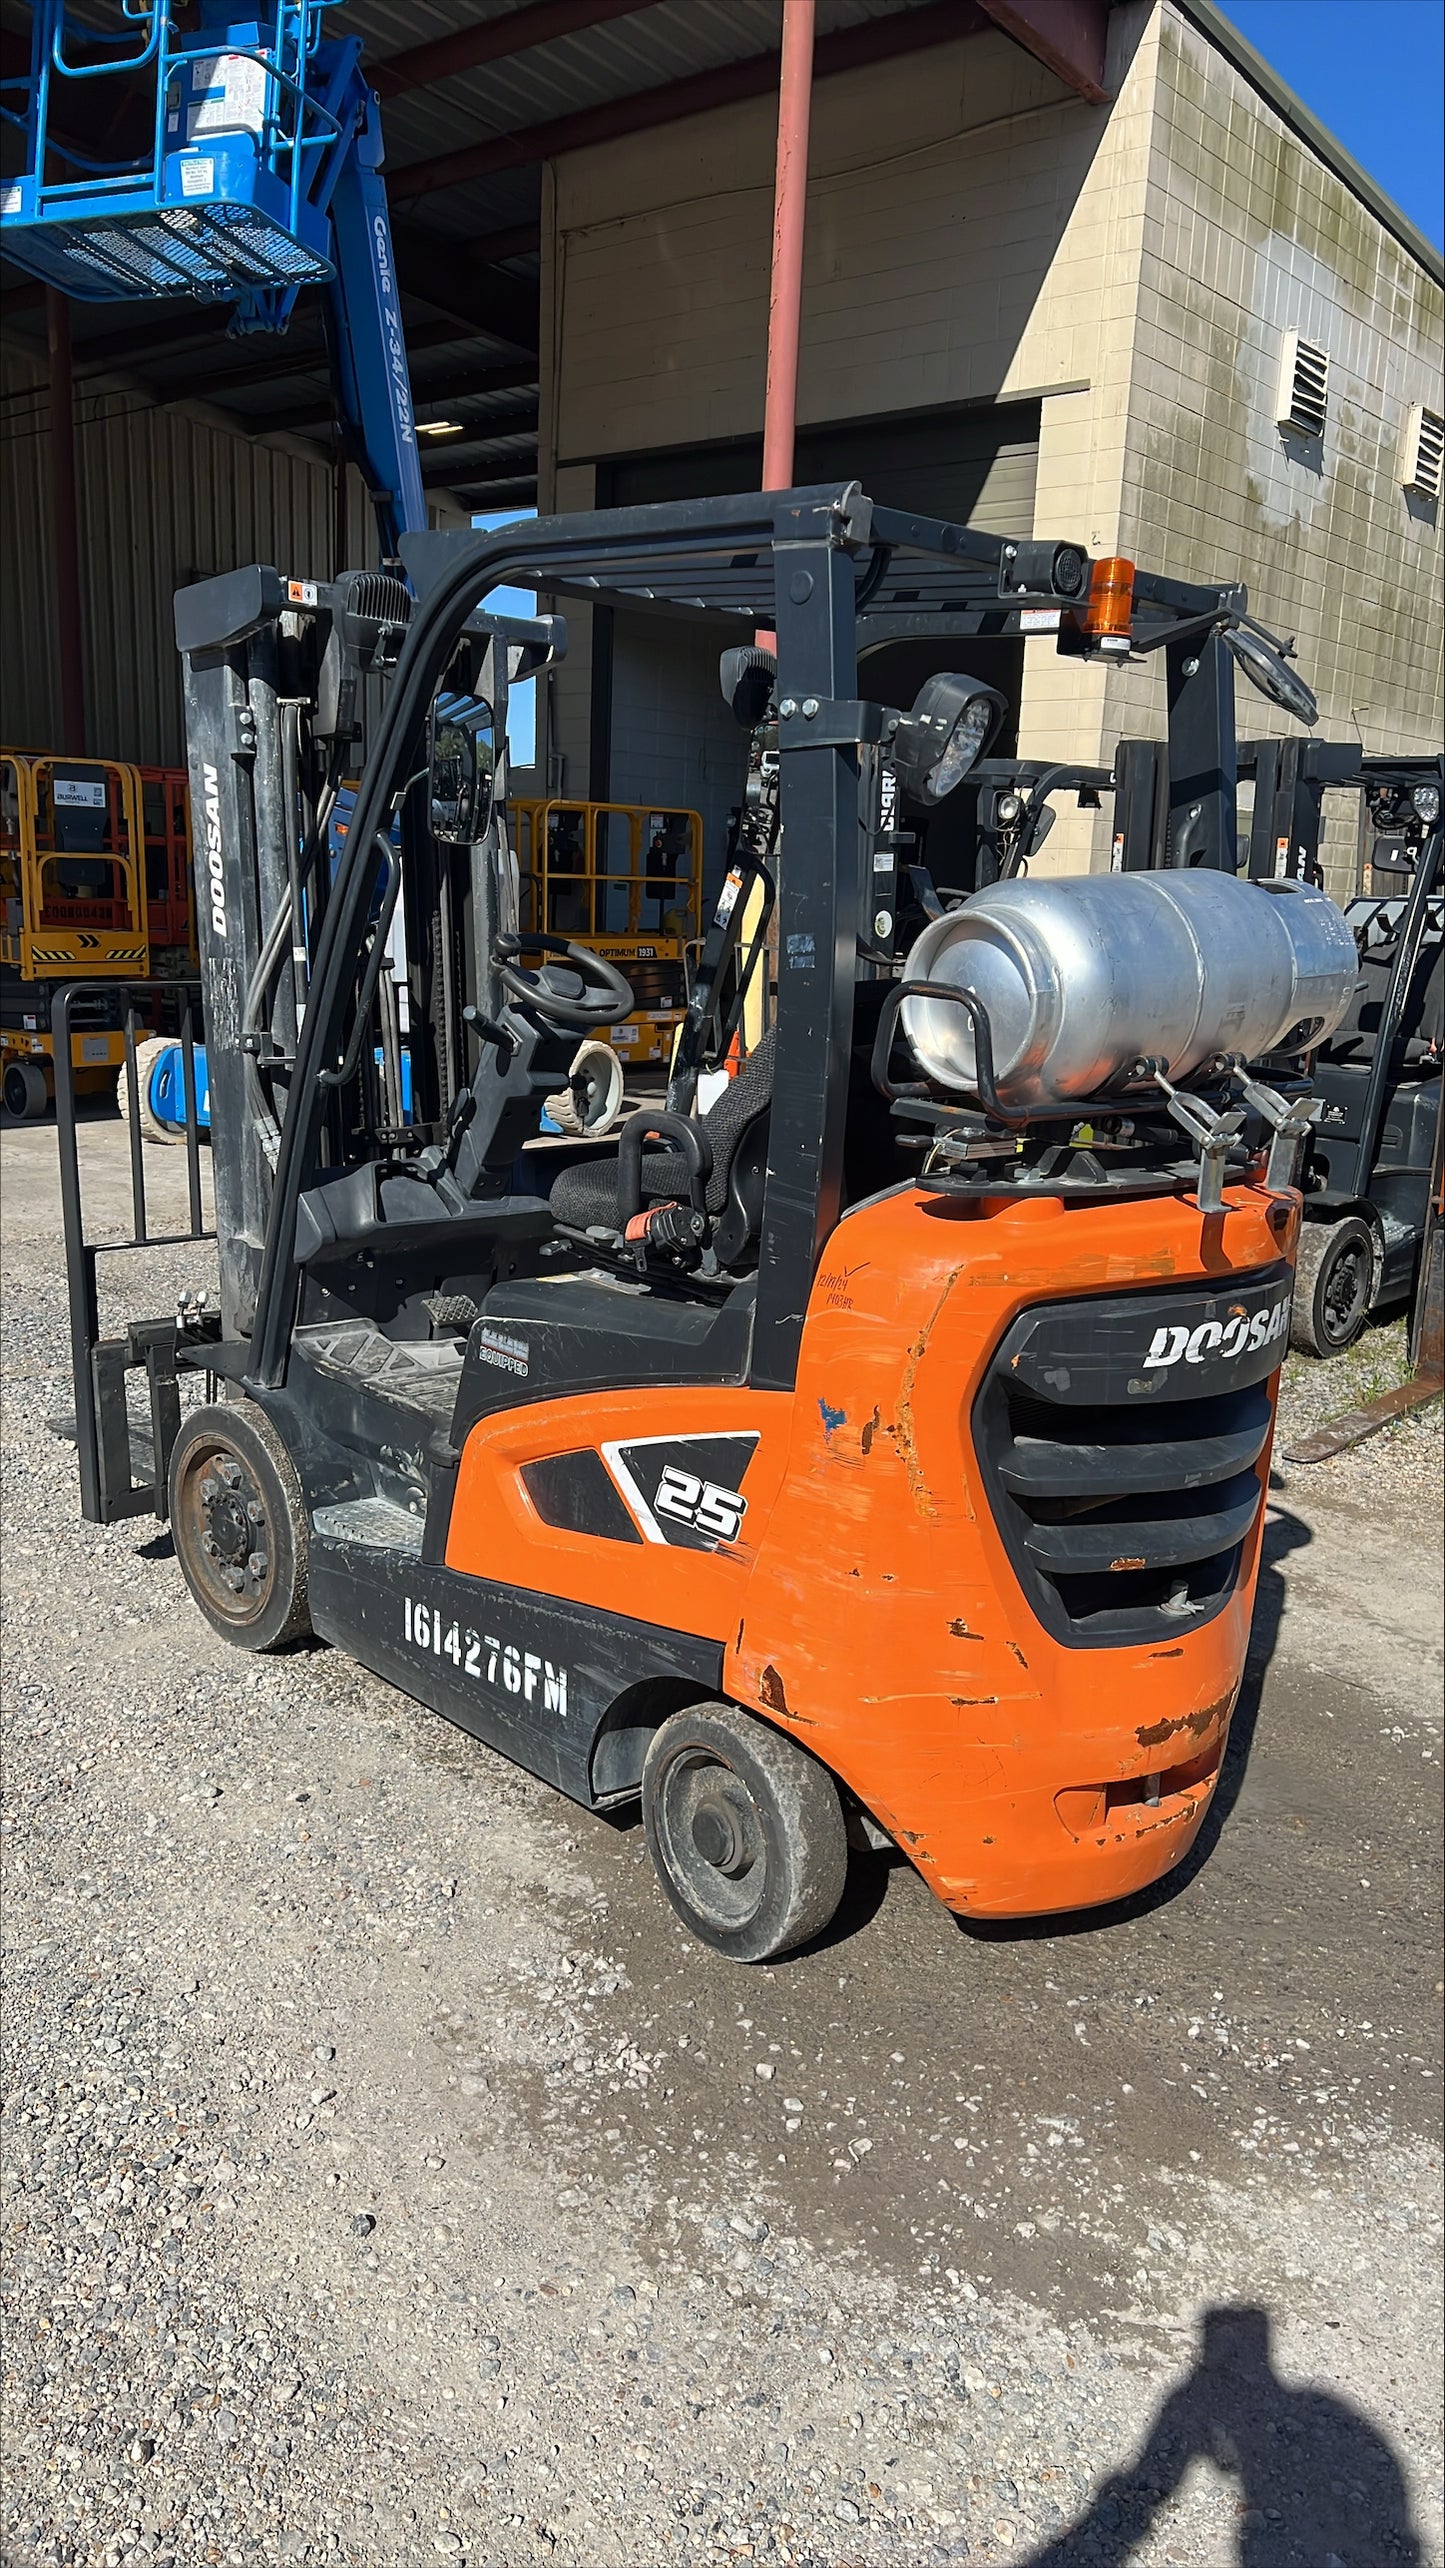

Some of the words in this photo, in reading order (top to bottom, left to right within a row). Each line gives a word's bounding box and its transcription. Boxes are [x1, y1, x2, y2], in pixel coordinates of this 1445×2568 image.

[373, 215, 391, 294] Genie
[384, 307, 413, 444] Z-34/22N
[202, 762, 228, 938] DOOSAN
[600, 948, 636, 957] OPTIMUM
[639, 947, 654, 957] 1931
[479, 1345, 529, 1377] EQUIPPED
[653, 1464, 749, 1544] 25
[404, 1596, 568, 1718] 1614276FM
